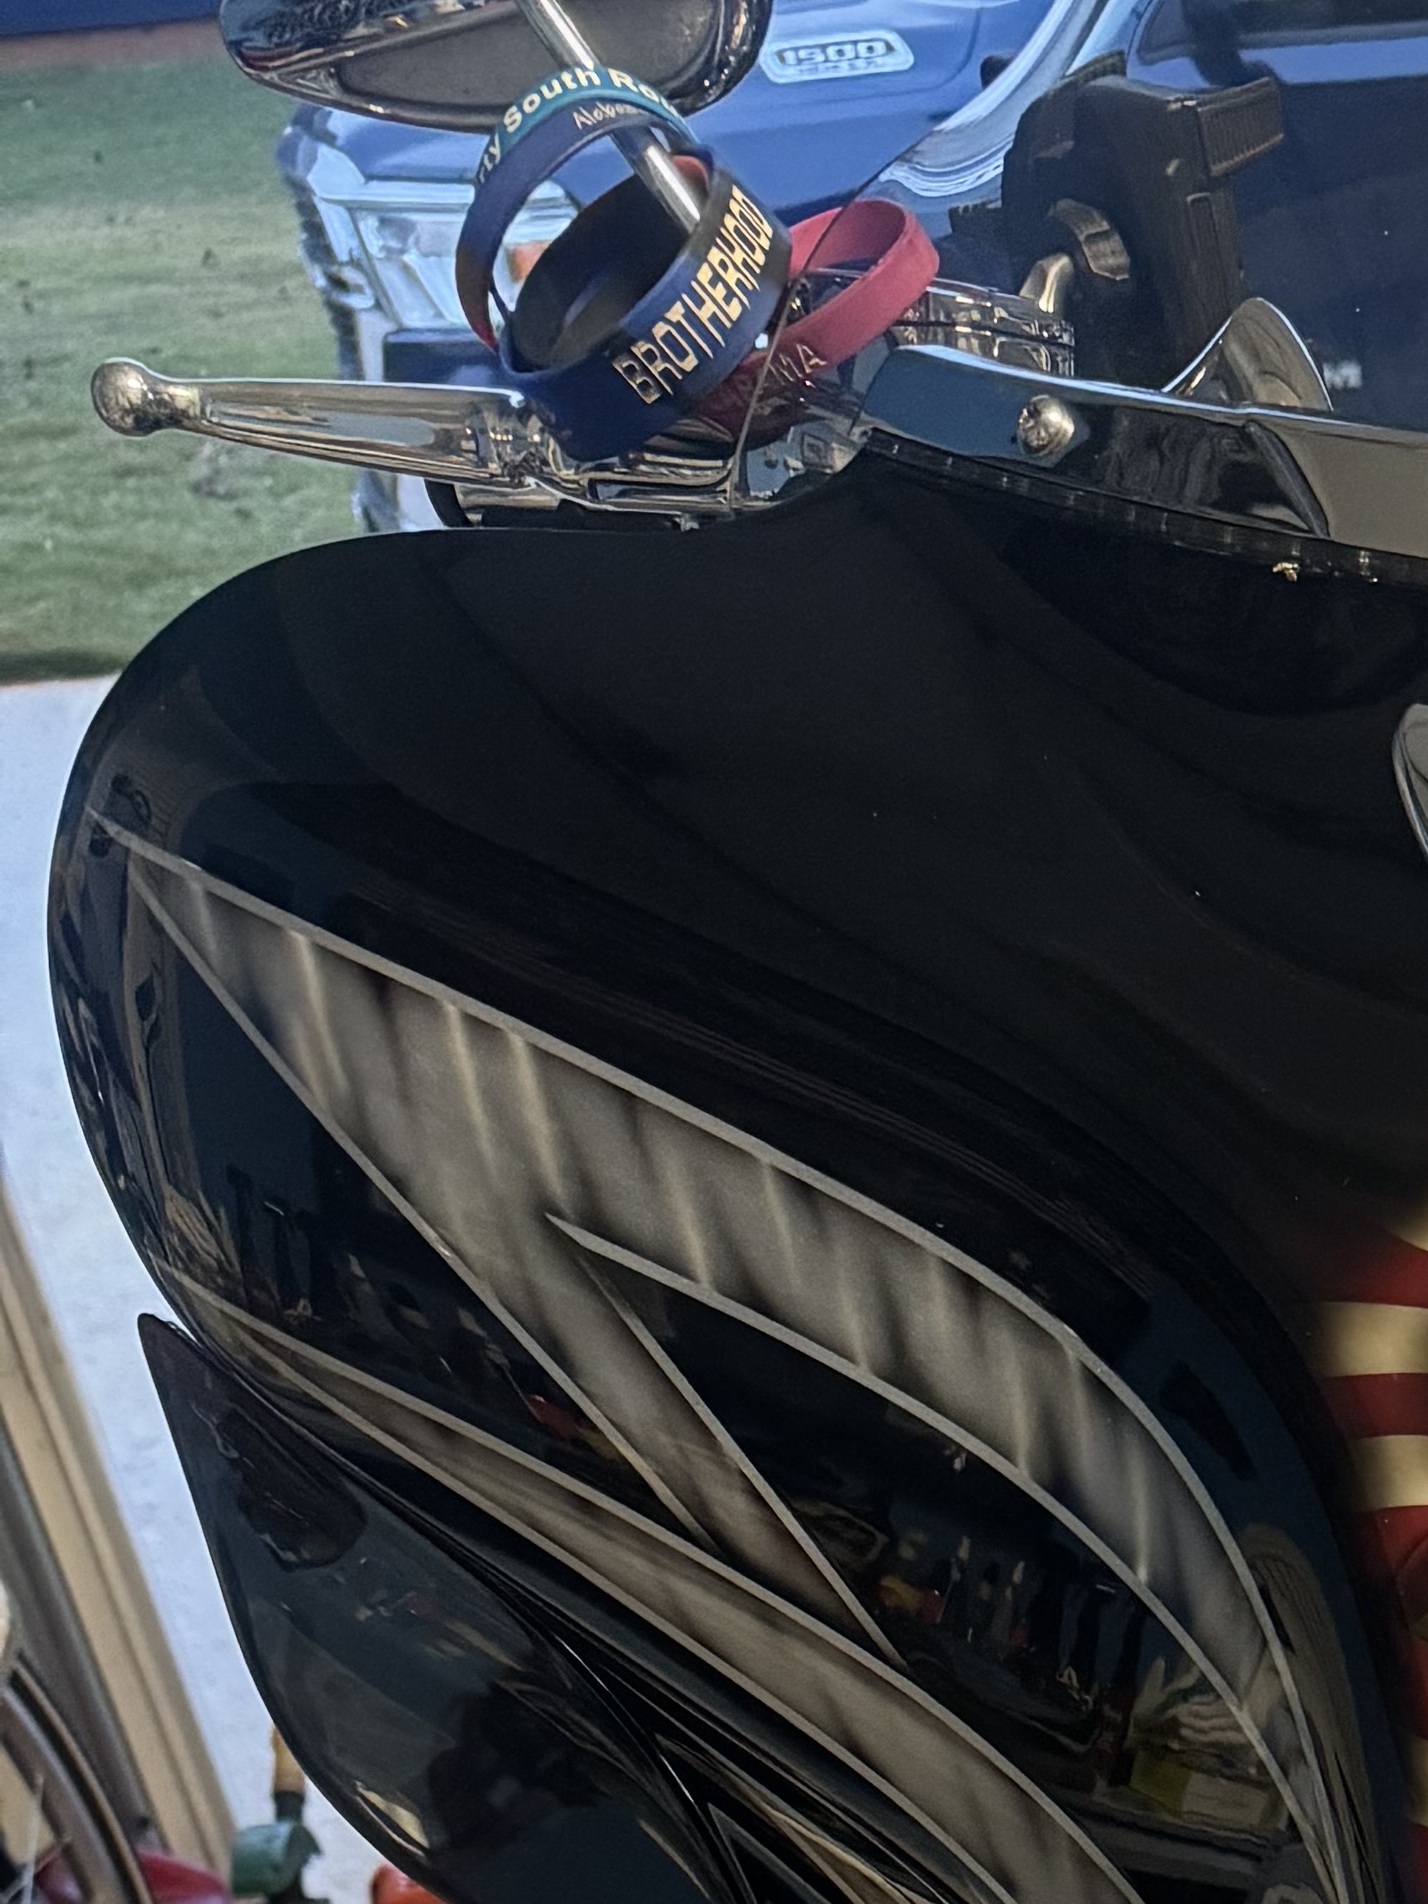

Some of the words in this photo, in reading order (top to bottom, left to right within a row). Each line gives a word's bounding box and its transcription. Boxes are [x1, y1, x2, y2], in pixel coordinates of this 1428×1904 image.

[783, 39, 887, 66] 1500
[502, 67, 601, 134] South
[611, 184, 774, 405] BROTHERHOOD
